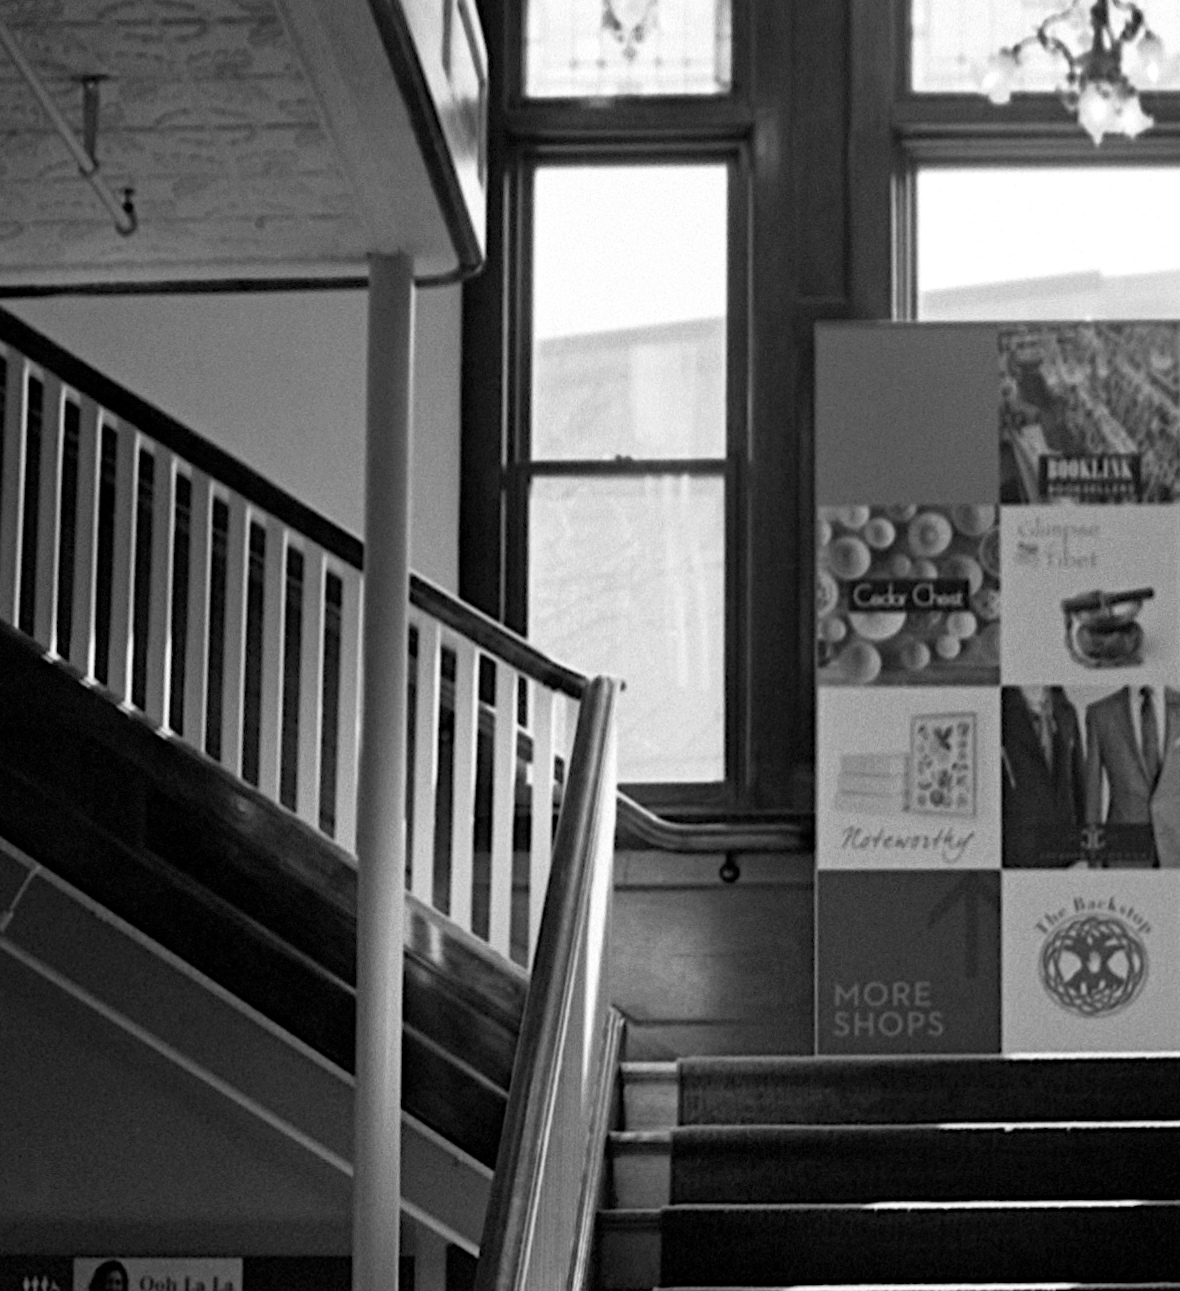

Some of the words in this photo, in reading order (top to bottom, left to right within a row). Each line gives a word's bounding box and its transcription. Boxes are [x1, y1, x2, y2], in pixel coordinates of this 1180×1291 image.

[1047, 457, 1132, 480] BOOKLINK
[841, 825, 975, 864] Noteworthy
[1035, 907, 1067, 936] The
[1073, 896, 1153, 935] Backstop
[833, 980, 933, 1008] MORE
[832, 1010, 945, 1038] SHOPS
